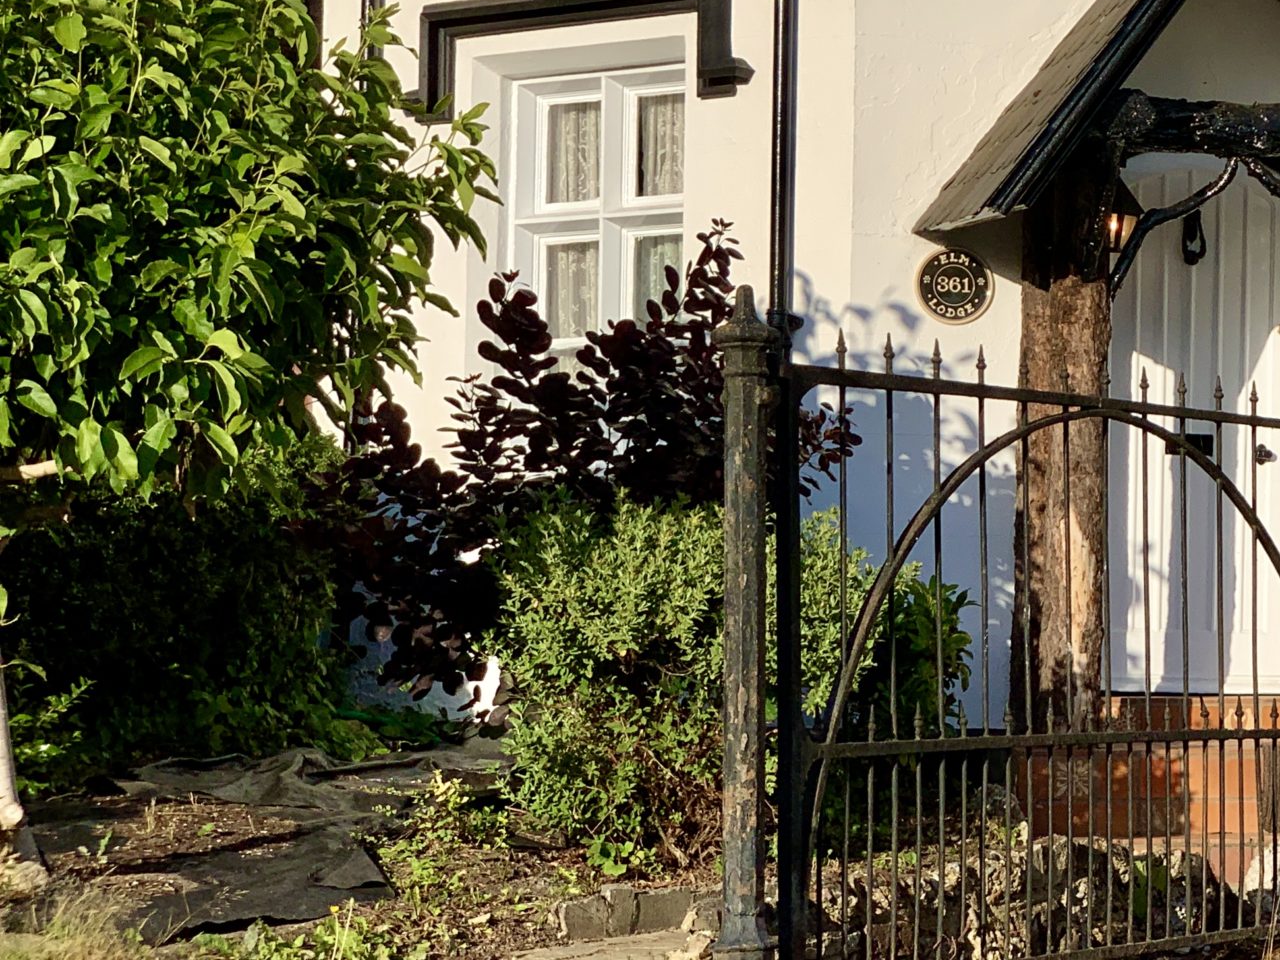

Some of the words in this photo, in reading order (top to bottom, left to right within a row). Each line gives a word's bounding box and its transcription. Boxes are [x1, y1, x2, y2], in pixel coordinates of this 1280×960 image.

[939, 252, 970, 266] ELM
[937, 276, 971, 293] 361
[928, 298, 975, 317] LODGE
